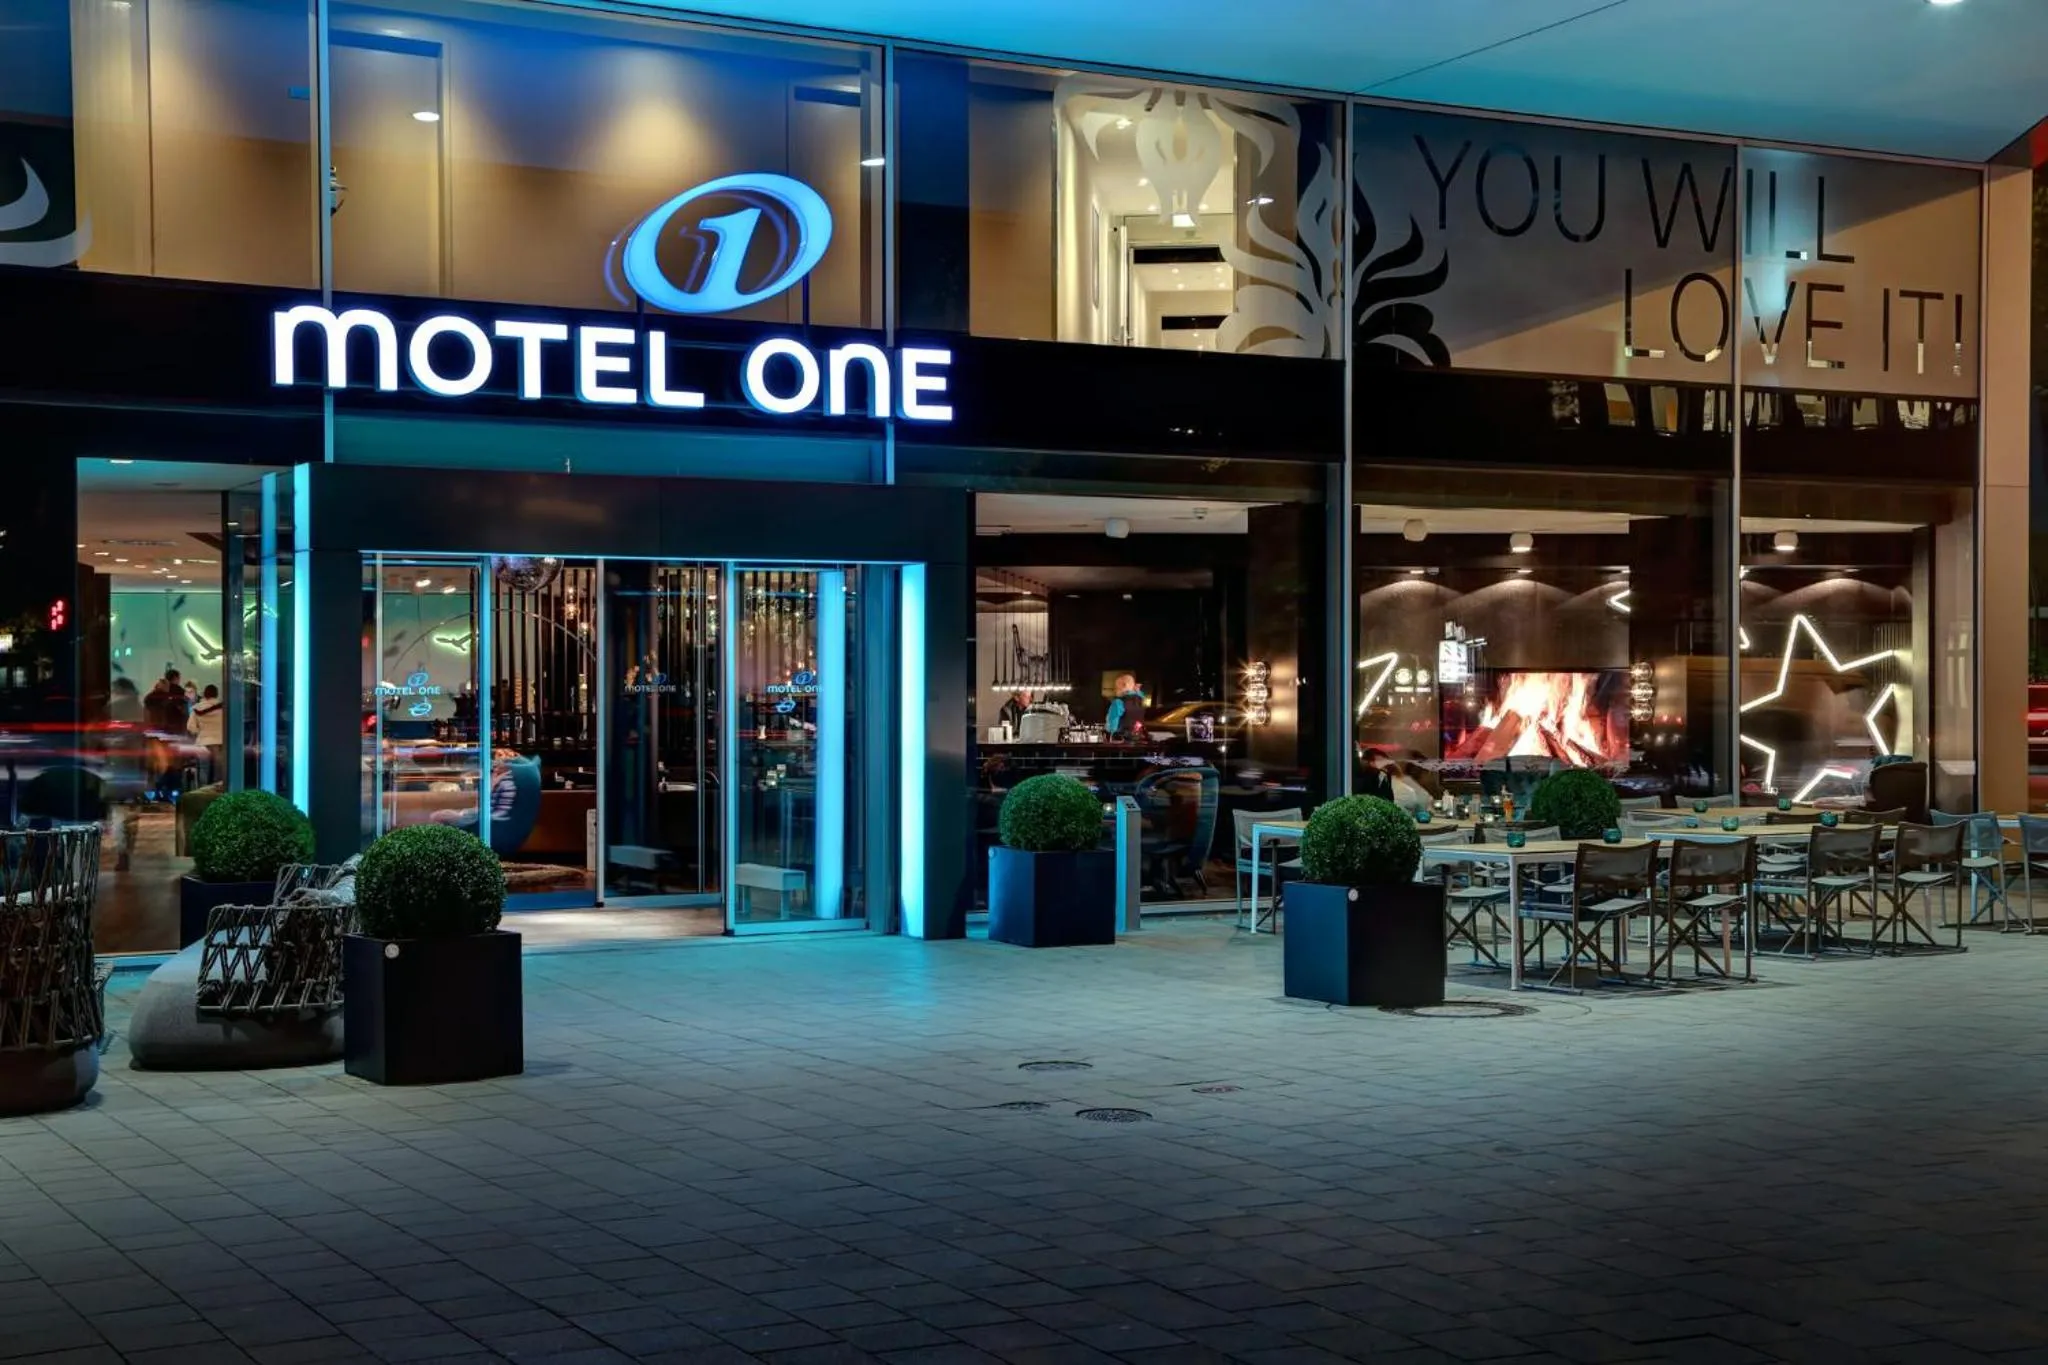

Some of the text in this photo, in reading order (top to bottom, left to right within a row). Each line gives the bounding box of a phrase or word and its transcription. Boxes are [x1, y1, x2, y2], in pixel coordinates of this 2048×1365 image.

[1414, 135, 1855, 264] YOU WILL
[273, 305, 953, 421] MOTEL ONE
[1624, 268, 1963, 376] LOVE IT!
[418, 686, 441, 696] ONE
